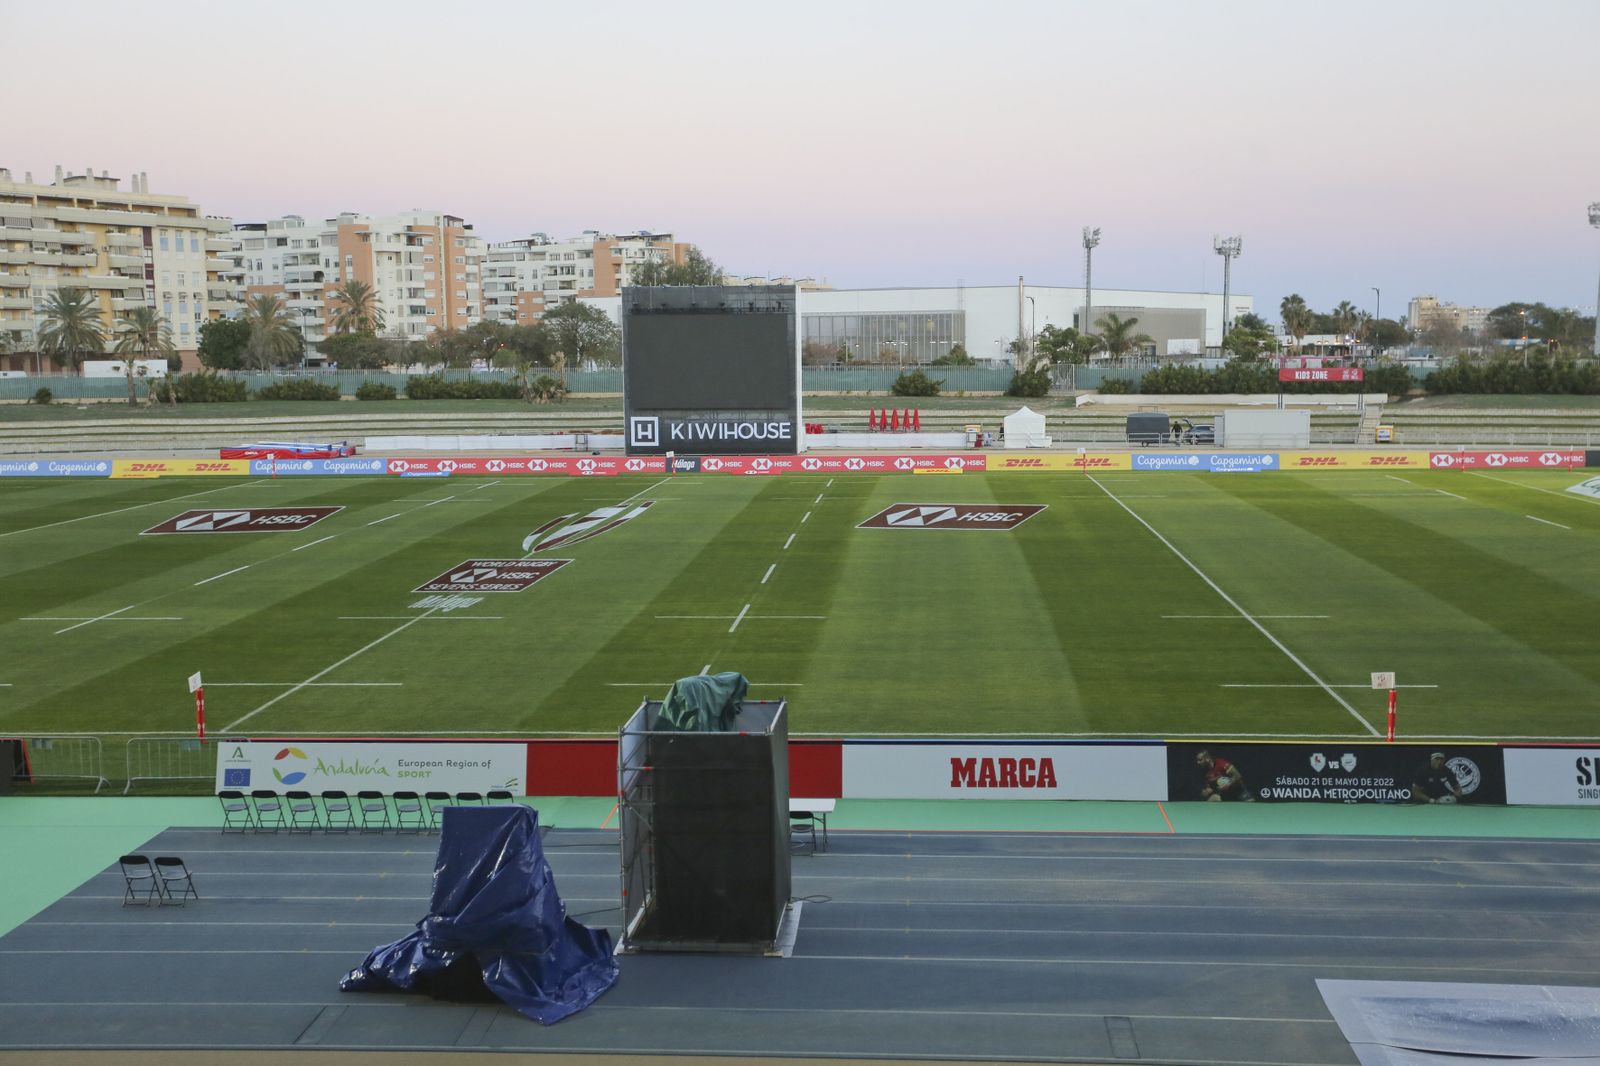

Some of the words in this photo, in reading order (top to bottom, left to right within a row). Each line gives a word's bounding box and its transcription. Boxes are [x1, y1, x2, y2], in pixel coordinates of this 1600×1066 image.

[1295, 371, 1310, 379] KIDS
[1312, 371, 1328, 379] ZONE
[671, 422, 791, 439] KIWIHOUSE
[1005, 458, 1044, 467] DHL
[1072, 458, 1112, 467] DHL
[1137, 455, 1187, 469] Capgemini
[1210, 455, 1260, 468] Capgemini
[1299, 457, 1339, 466] DHL
[1369, 456, 1409, 465] DHL
[0, 461, 28, 475] emini
[49, 461, 96, 475] Capgemini
[130, 463, 168, 472] DHL
[194, 463, 231, 472] DHL
[323, 460, 371, 474] Capgemini
[249, 514, 317, 525] HSBC
[957, 512, 1023, 522] HSBC
[398, 759, 443, 768] European
[446, 759, 478, 769] Region
[481, 759, 492, 769] of
[398, 770, 431, 778] SPORT
[950, 757, 1057, 788] MARCA
[1276, 776, 1310, 786] SÁBADO
[1311, 777, 1320, 786] 21
[1322, 778, 1333, 786] DE
[1335, 778, 1358, 786] MAYO
[1361, 778, 1372, 786] DE
[1374, 778, 1394, 786] 2022
[1273, 788, 1321, 799] WANDA
[1324, 788, 1411, 800] METROPOLITANO
